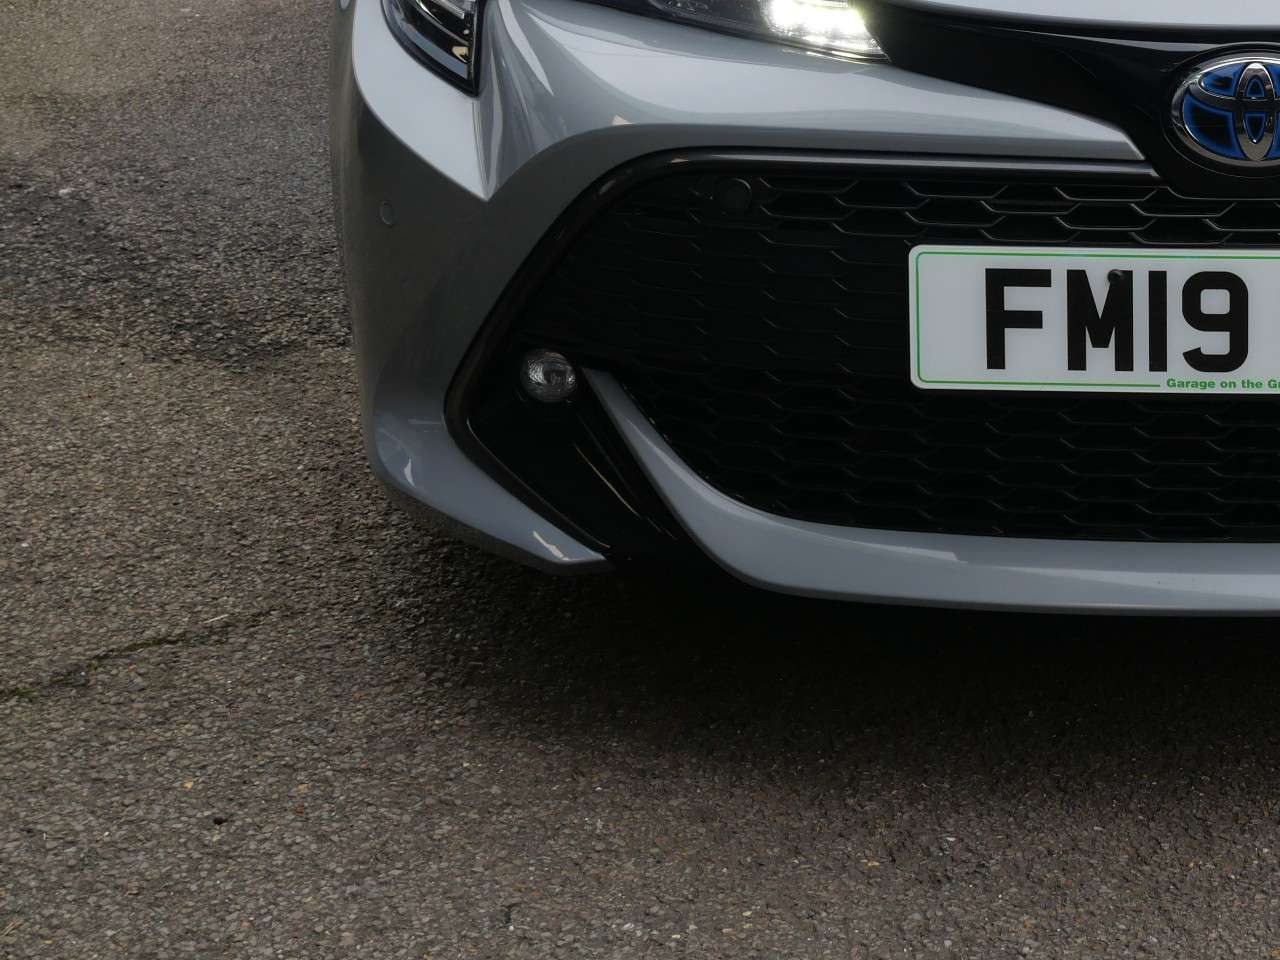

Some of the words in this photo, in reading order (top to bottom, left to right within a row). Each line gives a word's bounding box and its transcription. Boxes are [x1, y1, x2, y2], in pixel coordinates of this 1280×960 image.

[984, 268, 1249, 373] FM19
[1166, 377, 1216, 391] Garage
[1219, 379, 1237, 389] on
[1241, 378, 1263, 389] the
